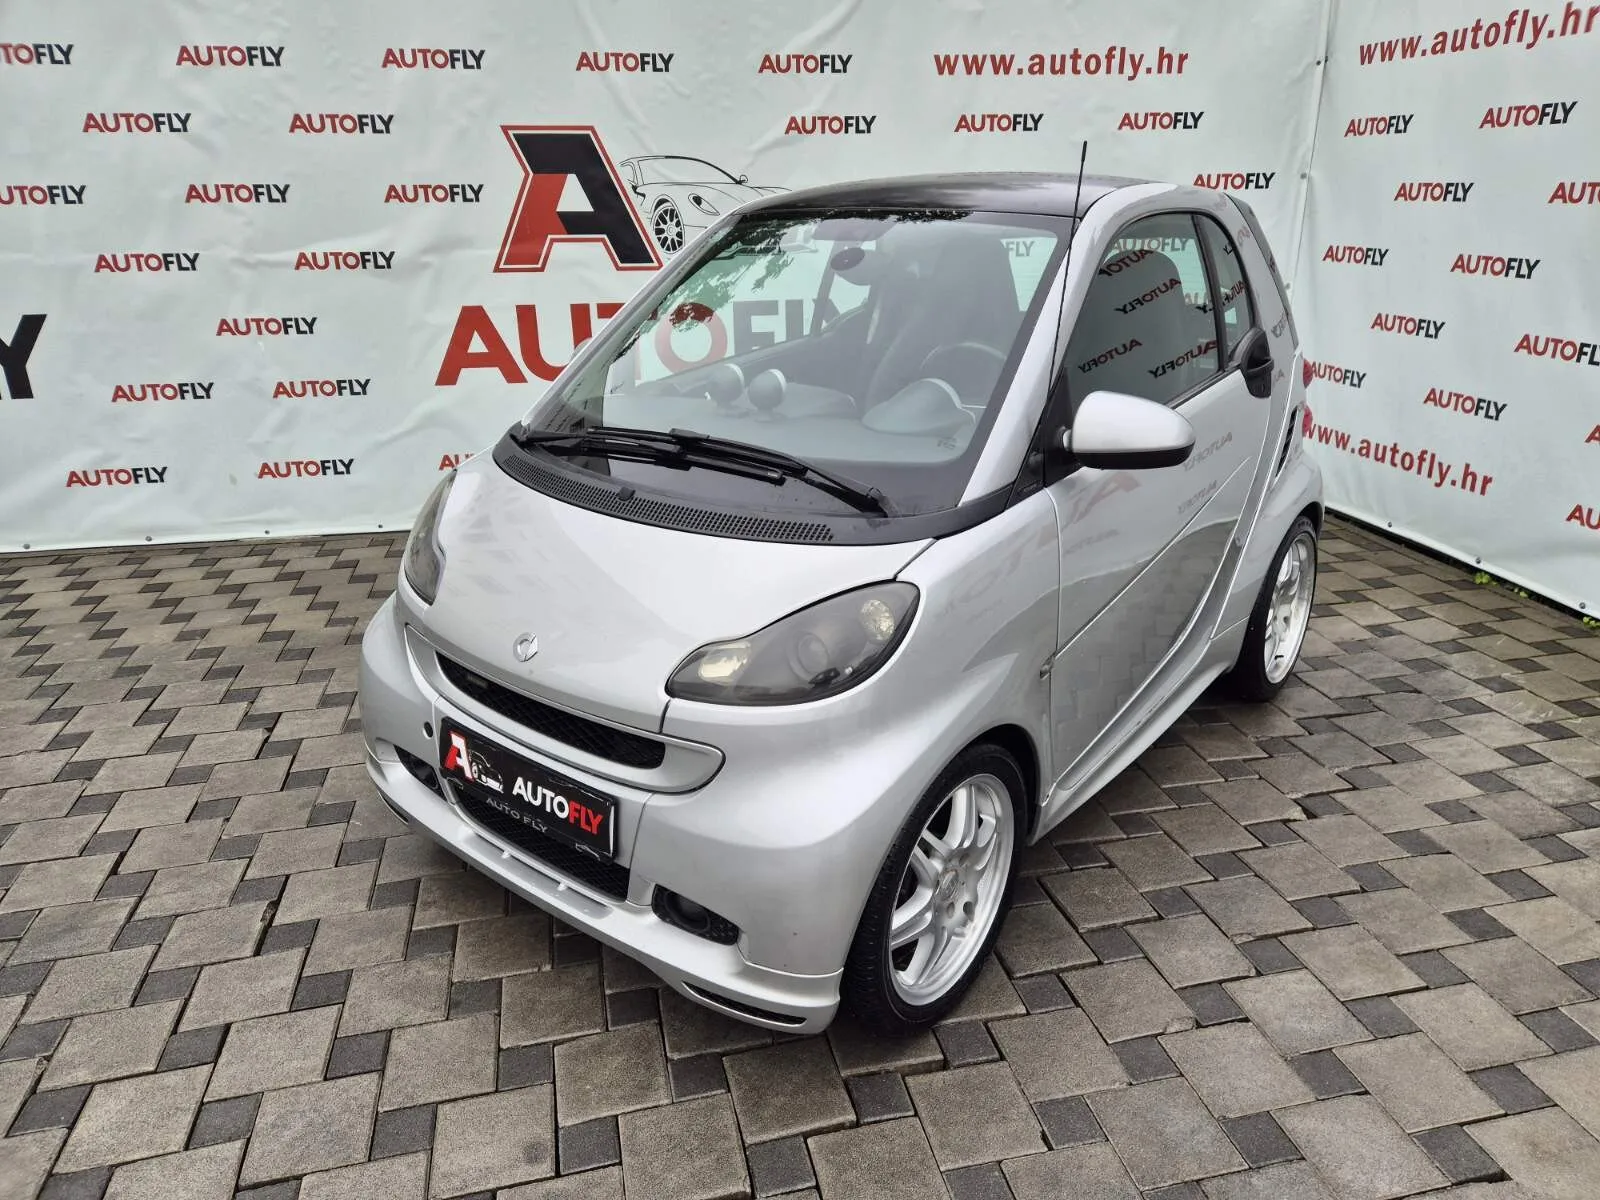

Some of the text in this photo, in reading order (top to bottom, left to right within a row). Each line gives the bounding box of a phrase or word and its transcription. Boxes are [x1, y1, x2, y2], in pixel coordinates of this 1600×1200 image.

[1360, 2, 1600, 65] www.autofly.hr
[0, 44, 73, 64] TOFLY
[177, 46, 284, 66] AUTOFLY
[382, 48, 485, 69] AUTOFLY
[576, 52, 674, 72] AUTOFLY
[759, 54, 852, 73] AUTOFLY
[934, 46, 1188, 81] www.autofly.hr
[83, 113, 191, 132] AUTOFLY
[289, 114, 394, 134] AUTOFLY
[955, 114, 1043, 132] AUTOFLY
[1118, 112, 1204, 130] AUTOFLY
[1480, 101, 1577, 128] AUTOFLY
[785, 116, 876, 134] AUTOFLY
[1345, 114, 1414, 137] AUTOFLY
[1194, 172, 1275, 190] AUTOFLY
[185, 184, 290, 203] AUTOFLY
[385, 184, 483, 203] AUTOFLY
[1394, 183, 1474, 202] AUTOFLY
[95, 253, 199, 272] AUTOFLY
[295, 251, 395, 270] AUTOFLY
[1323, 246, 1389, 266] AUTOFLY
[1451, 254, 1540, 279] AUTOFLY
[217, 317, 317, 336] AUTOFLY
[1371, 313, 1445, 339] AUTOFLY
[1515, 334, 1600, 366] AUTOFL
[1311, 362, 1366, 388] AUTOFLY
[112, 382, 214, 402] AUTOFLY
[273, 379, 370, 398] AUTOFLY
[1424, 388, 1507, 421] AUTOFLY
[66, 467, 167, 487] AUTOFLY
[258, 459, 354, 478] AUTOFLY
[513, 777, 603, 834] AUTOFLY
